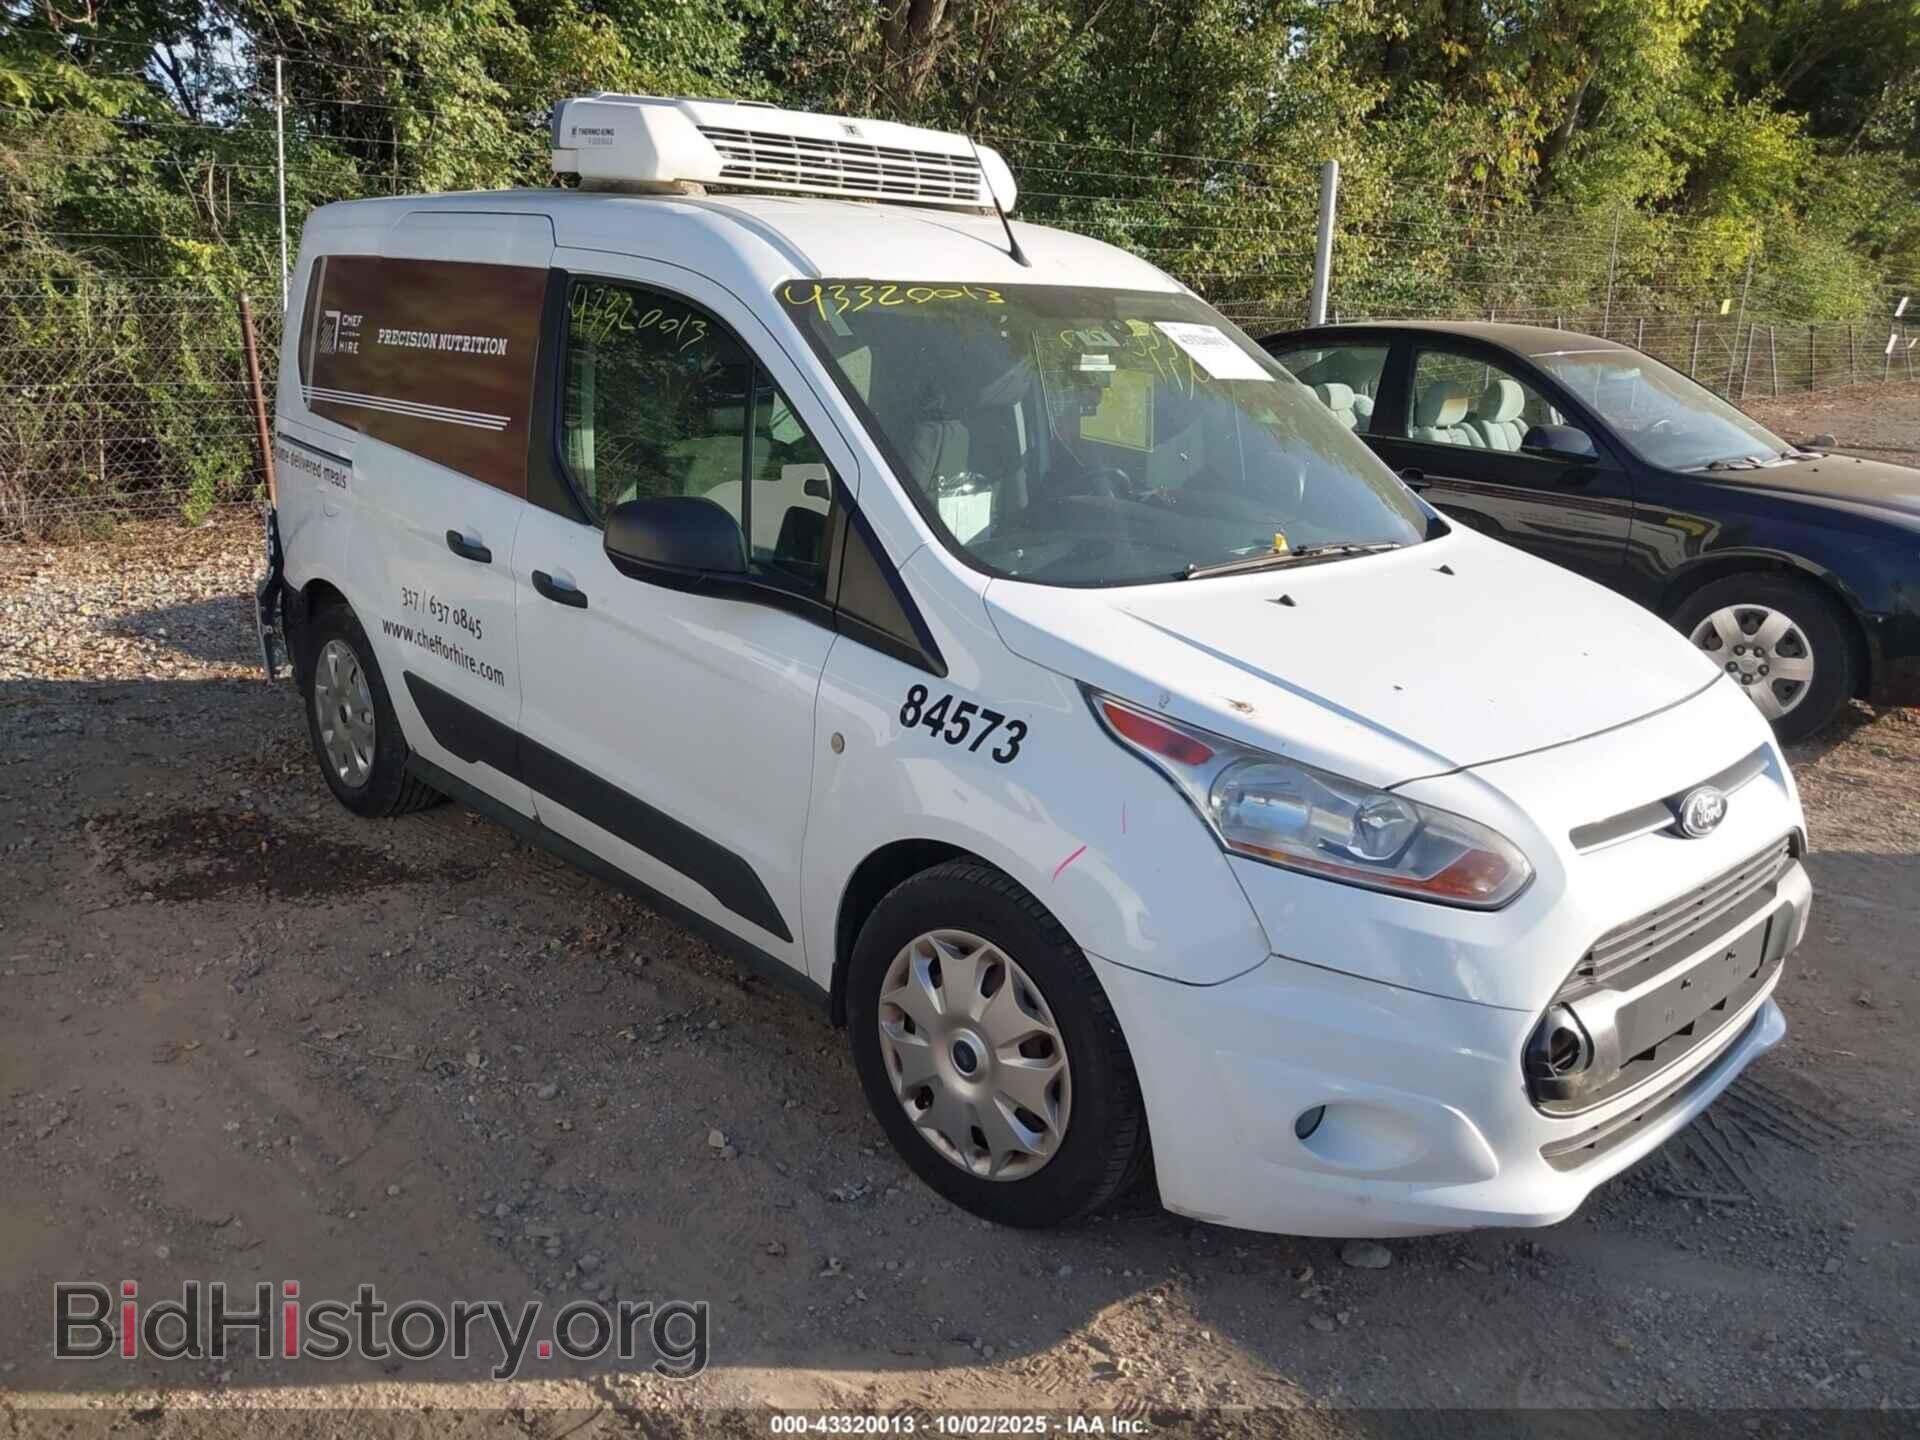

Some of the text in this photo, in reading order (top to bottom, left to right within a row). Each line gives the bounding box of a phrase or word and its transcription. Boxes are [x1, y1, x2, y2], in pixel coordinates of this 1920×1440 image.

[341, 314, 363, 327] CHEF
[784, 283, 1006, 321] 43320013
[338, 341, 360, 354] HIRE
[377, 328, 508, 355] PRECISION NUTRITION
[401, 586, 419, 612] 317
[428, 595, 450, 625] 637
[452, 608, 483, 640] 0845
[382, 619, 505, 687] www.chefforhire.com
[899, 684, 1028, 764] 84573
